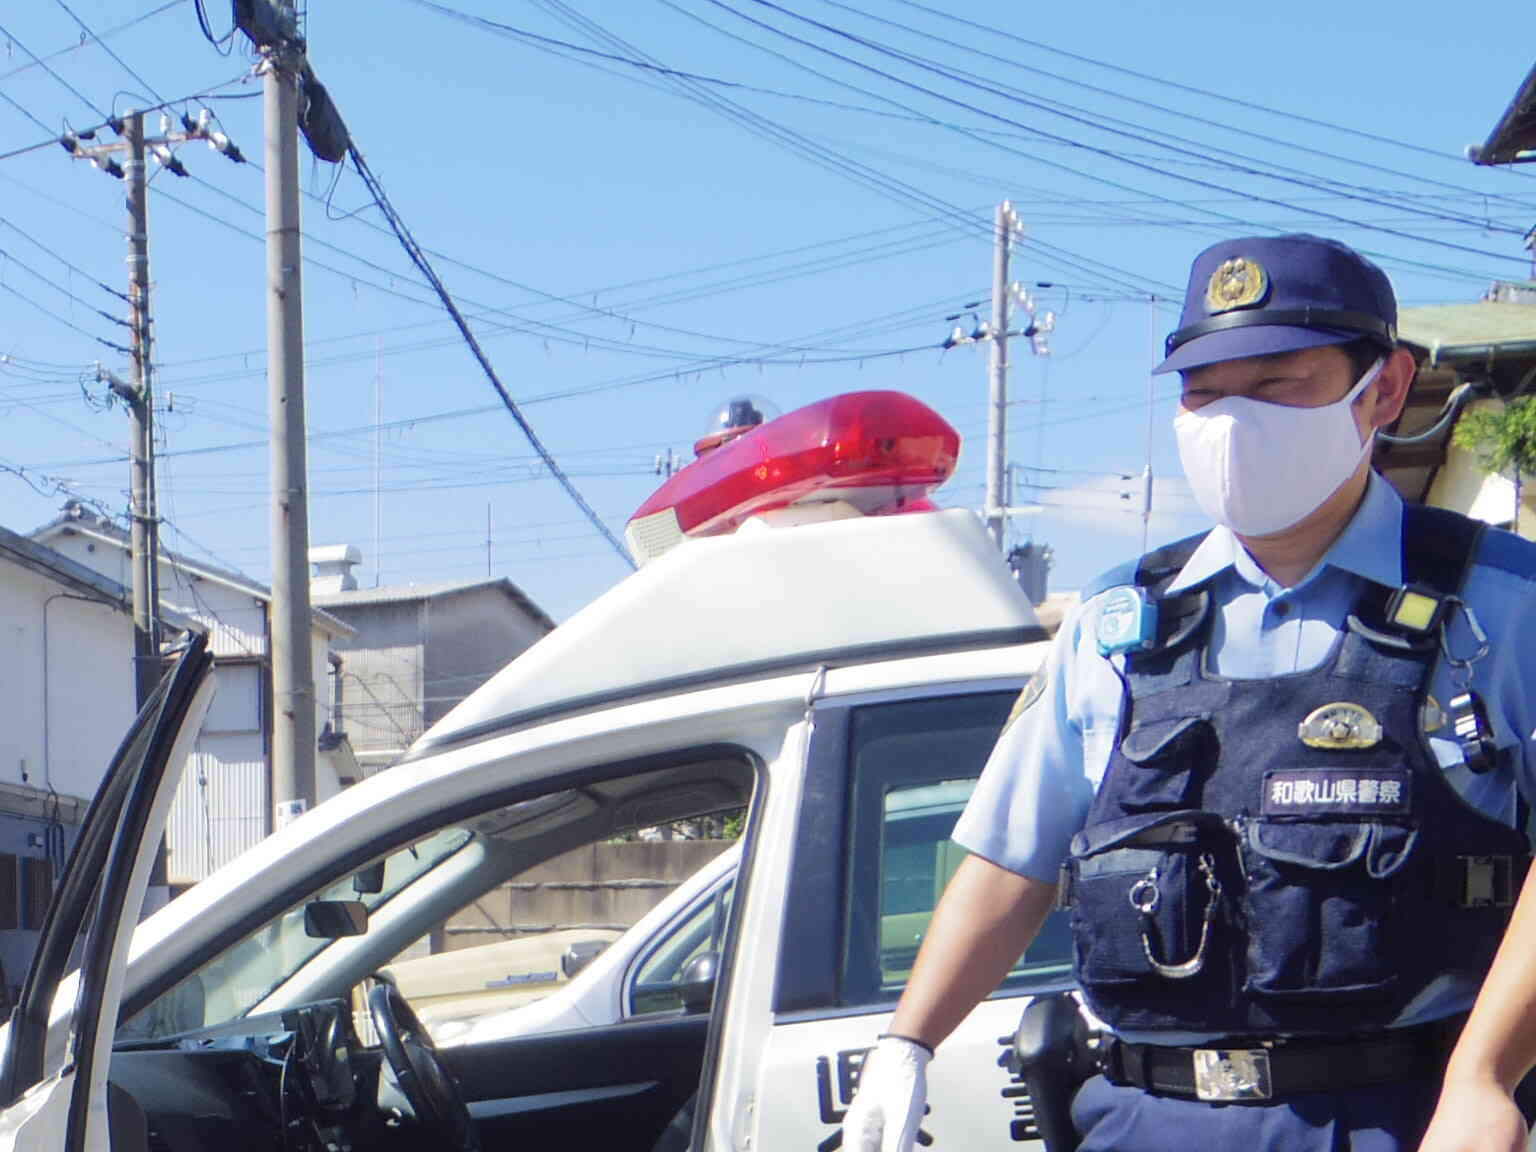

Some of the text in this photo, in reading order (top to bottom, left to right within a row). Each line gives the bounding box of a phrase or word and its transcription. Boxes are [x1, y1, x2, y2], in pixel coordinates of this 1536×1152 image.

[1271, 778, 1401, 804] 和歌山県警察
